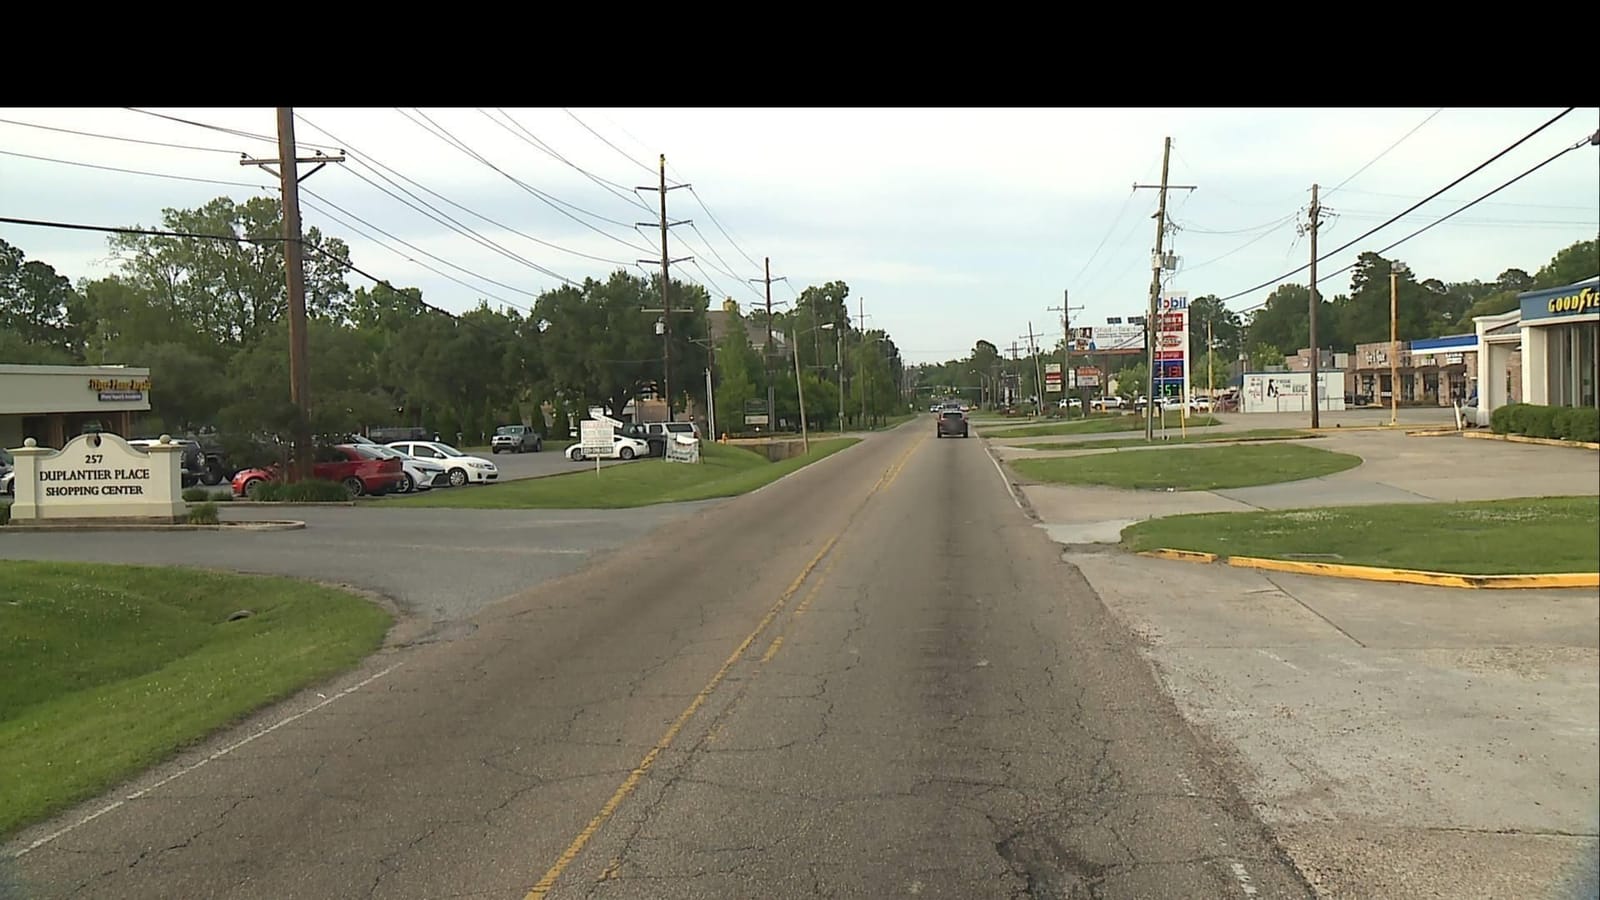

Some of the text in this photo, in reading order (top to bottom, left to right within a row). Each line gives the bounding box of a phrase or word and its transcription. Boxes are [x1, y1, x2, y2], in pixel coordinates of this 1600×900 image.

[85, 454, 104, 464] 257
[40, 469, 150, 481] DUPLANTIER PLACE
[46, 485, 143, 496] SHOPPING CENTER
